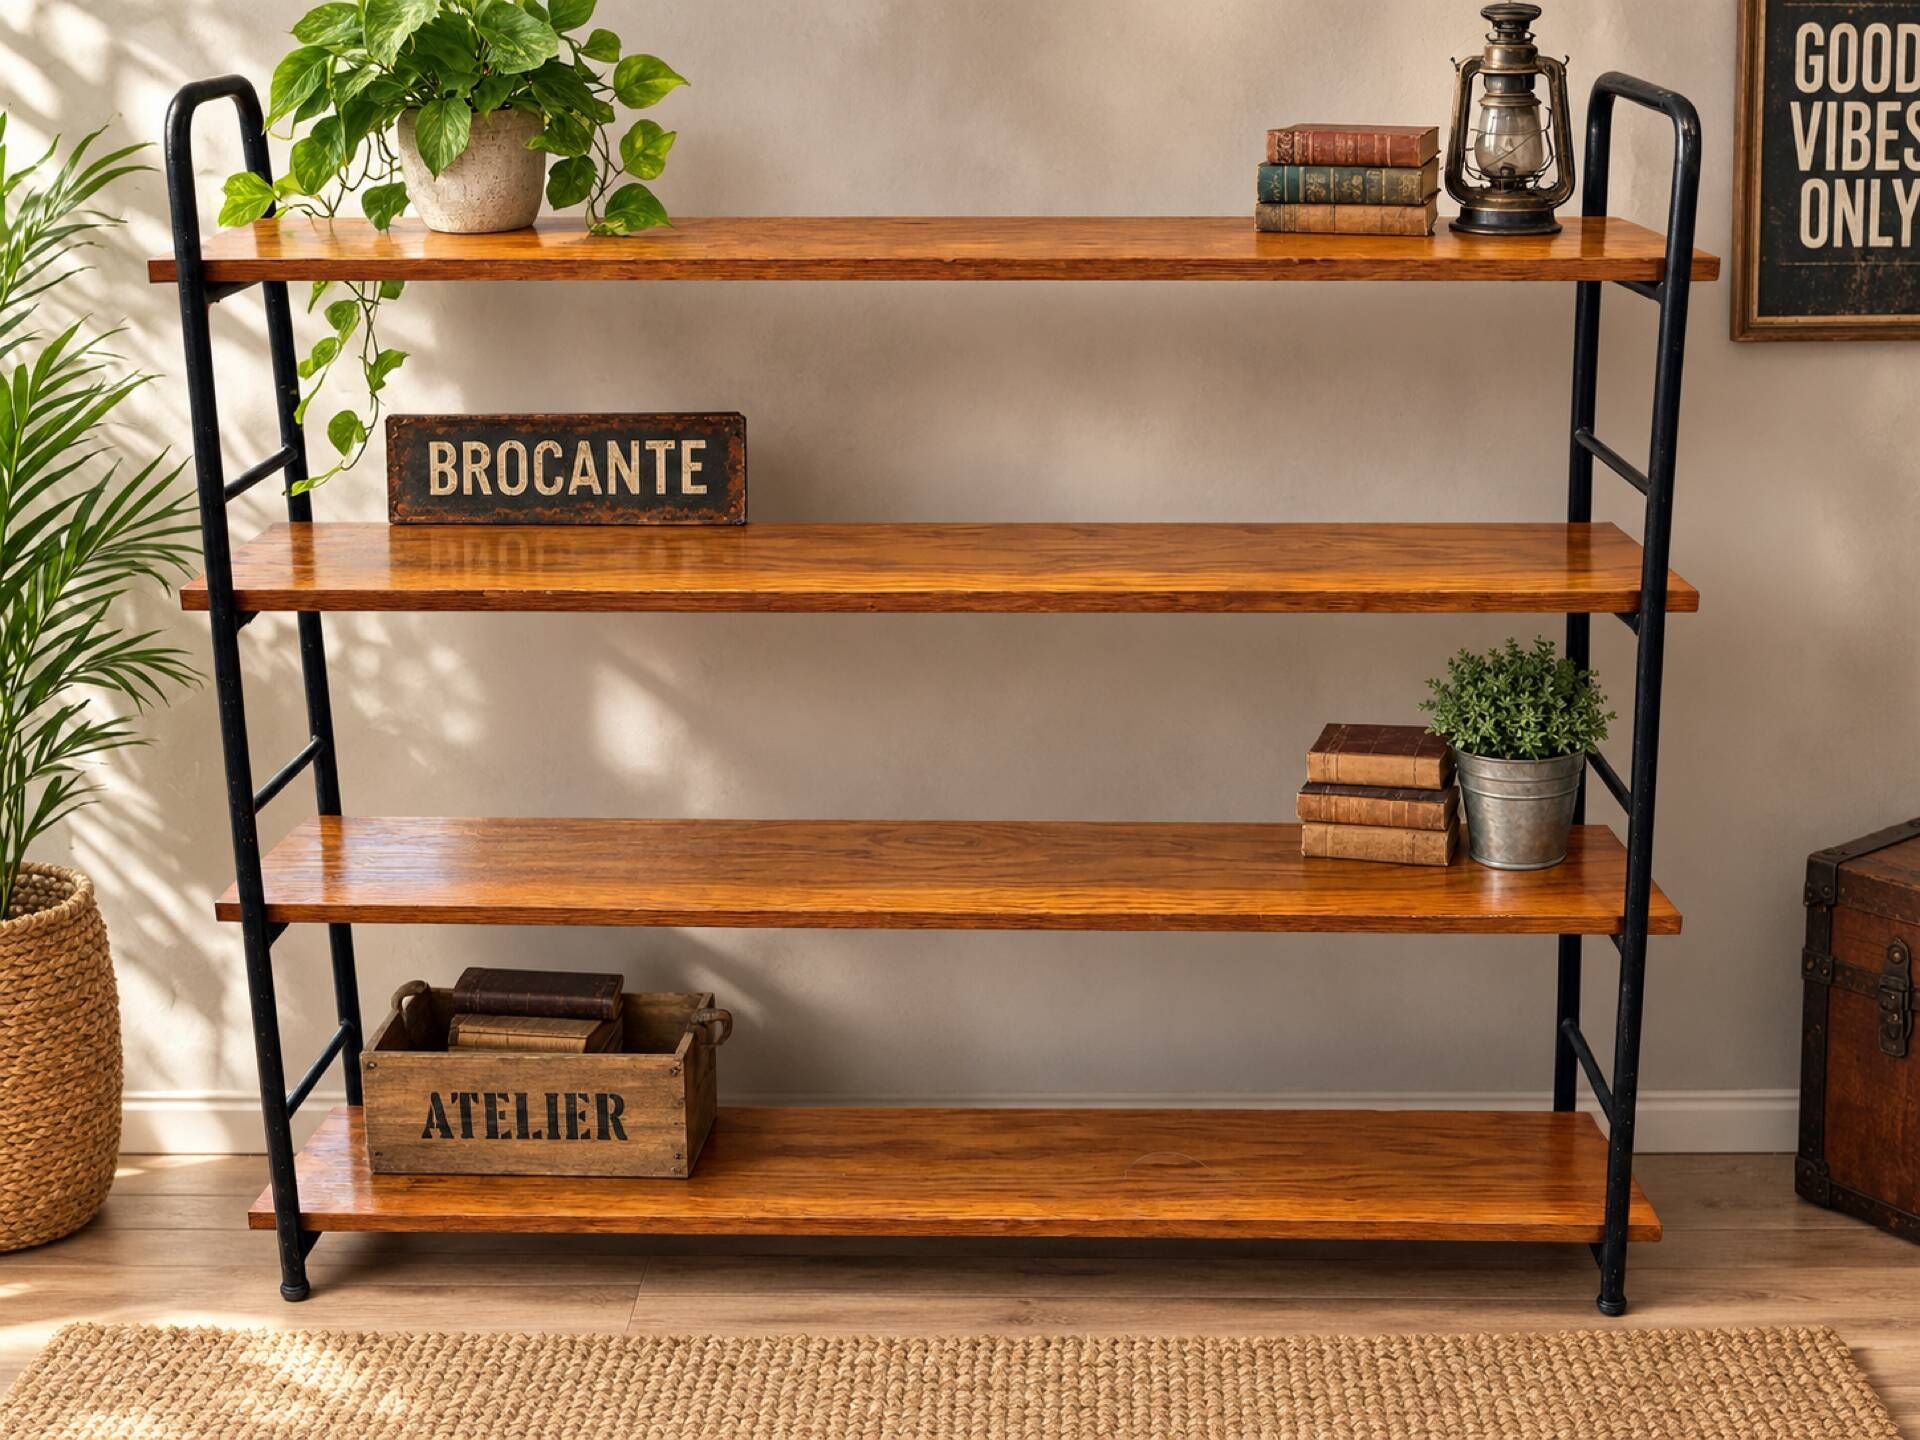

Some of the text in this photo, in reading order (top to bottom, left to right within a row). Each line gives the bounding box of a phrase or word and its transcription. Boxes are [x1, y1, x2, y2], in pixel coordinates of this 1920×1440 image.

[1794, 22, 1920, 94] GOOD
[1800, 178, 1920, 249] ONLY
[428, 439, 708, 496] BROCANTE
[421, 1091, 629, 1142] ATELIER
